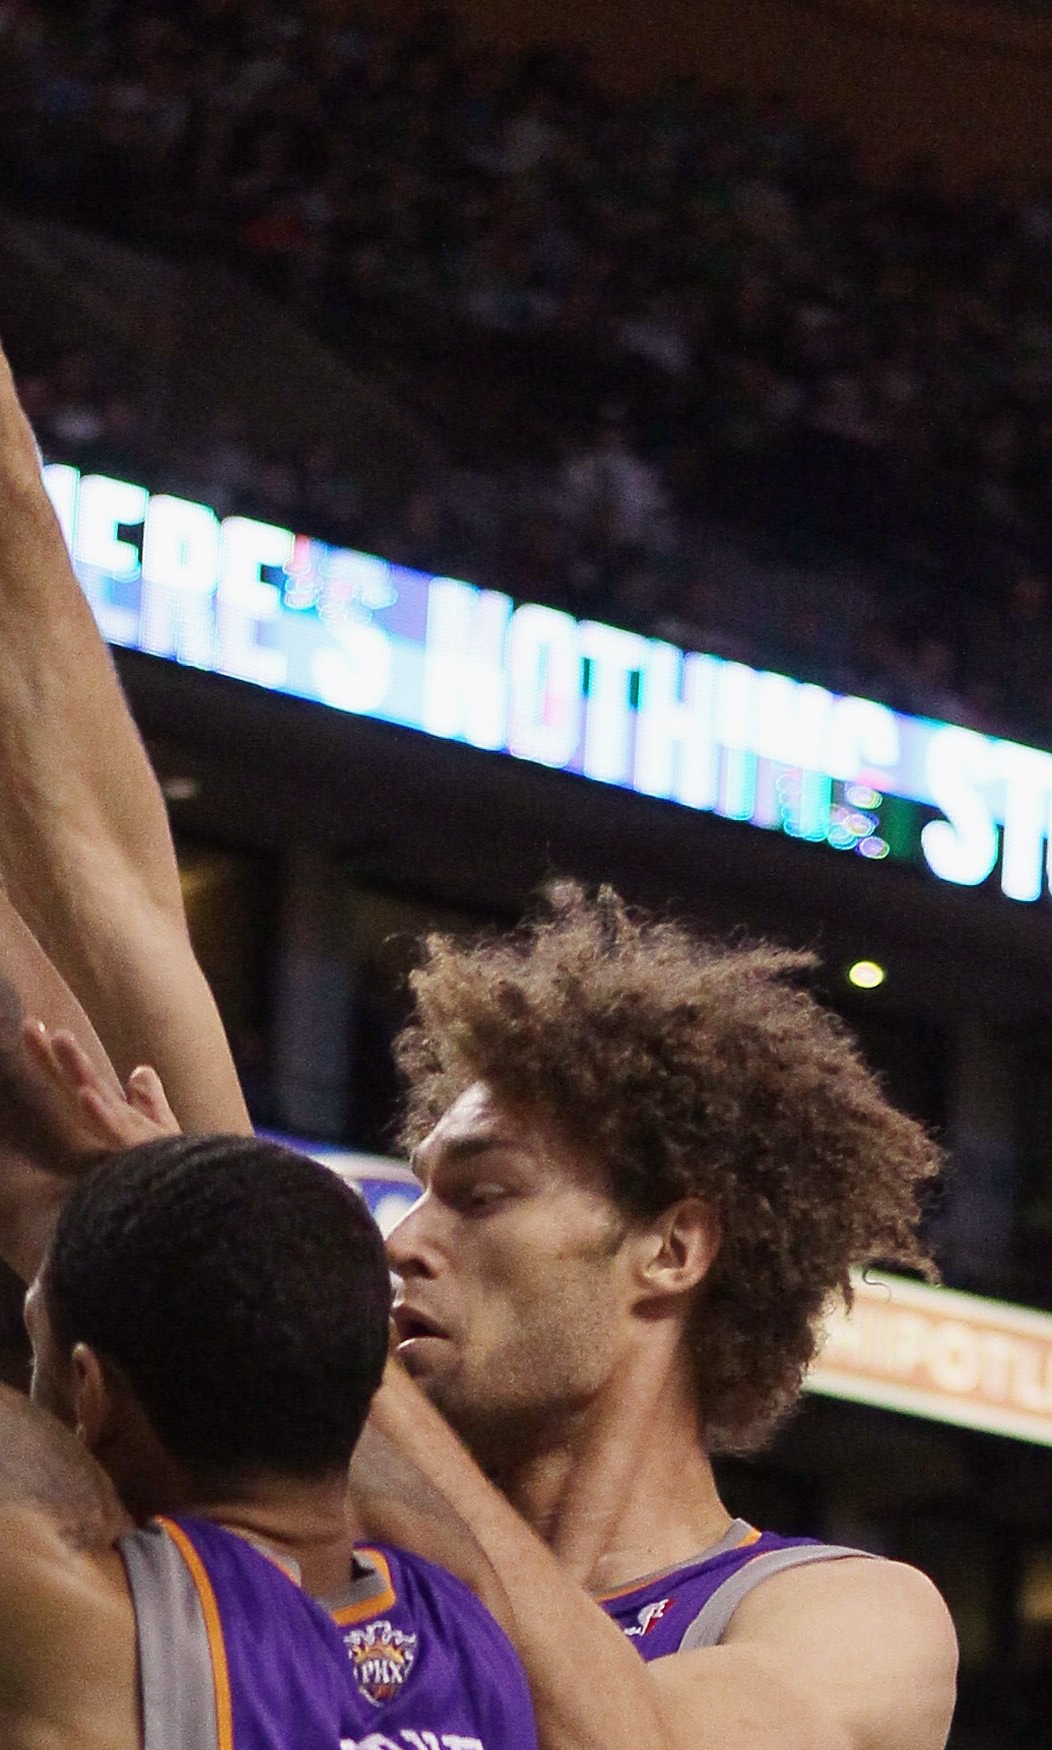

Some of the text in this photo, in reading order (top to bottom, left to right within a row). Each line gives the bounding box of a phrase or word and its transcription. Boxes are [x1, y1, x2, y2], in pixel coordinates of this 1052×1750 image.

[42, 464, 394, 714] ERE'S
[921, 723, 1052, 902] ST
[361, 1659, 403, 1684] PHX
